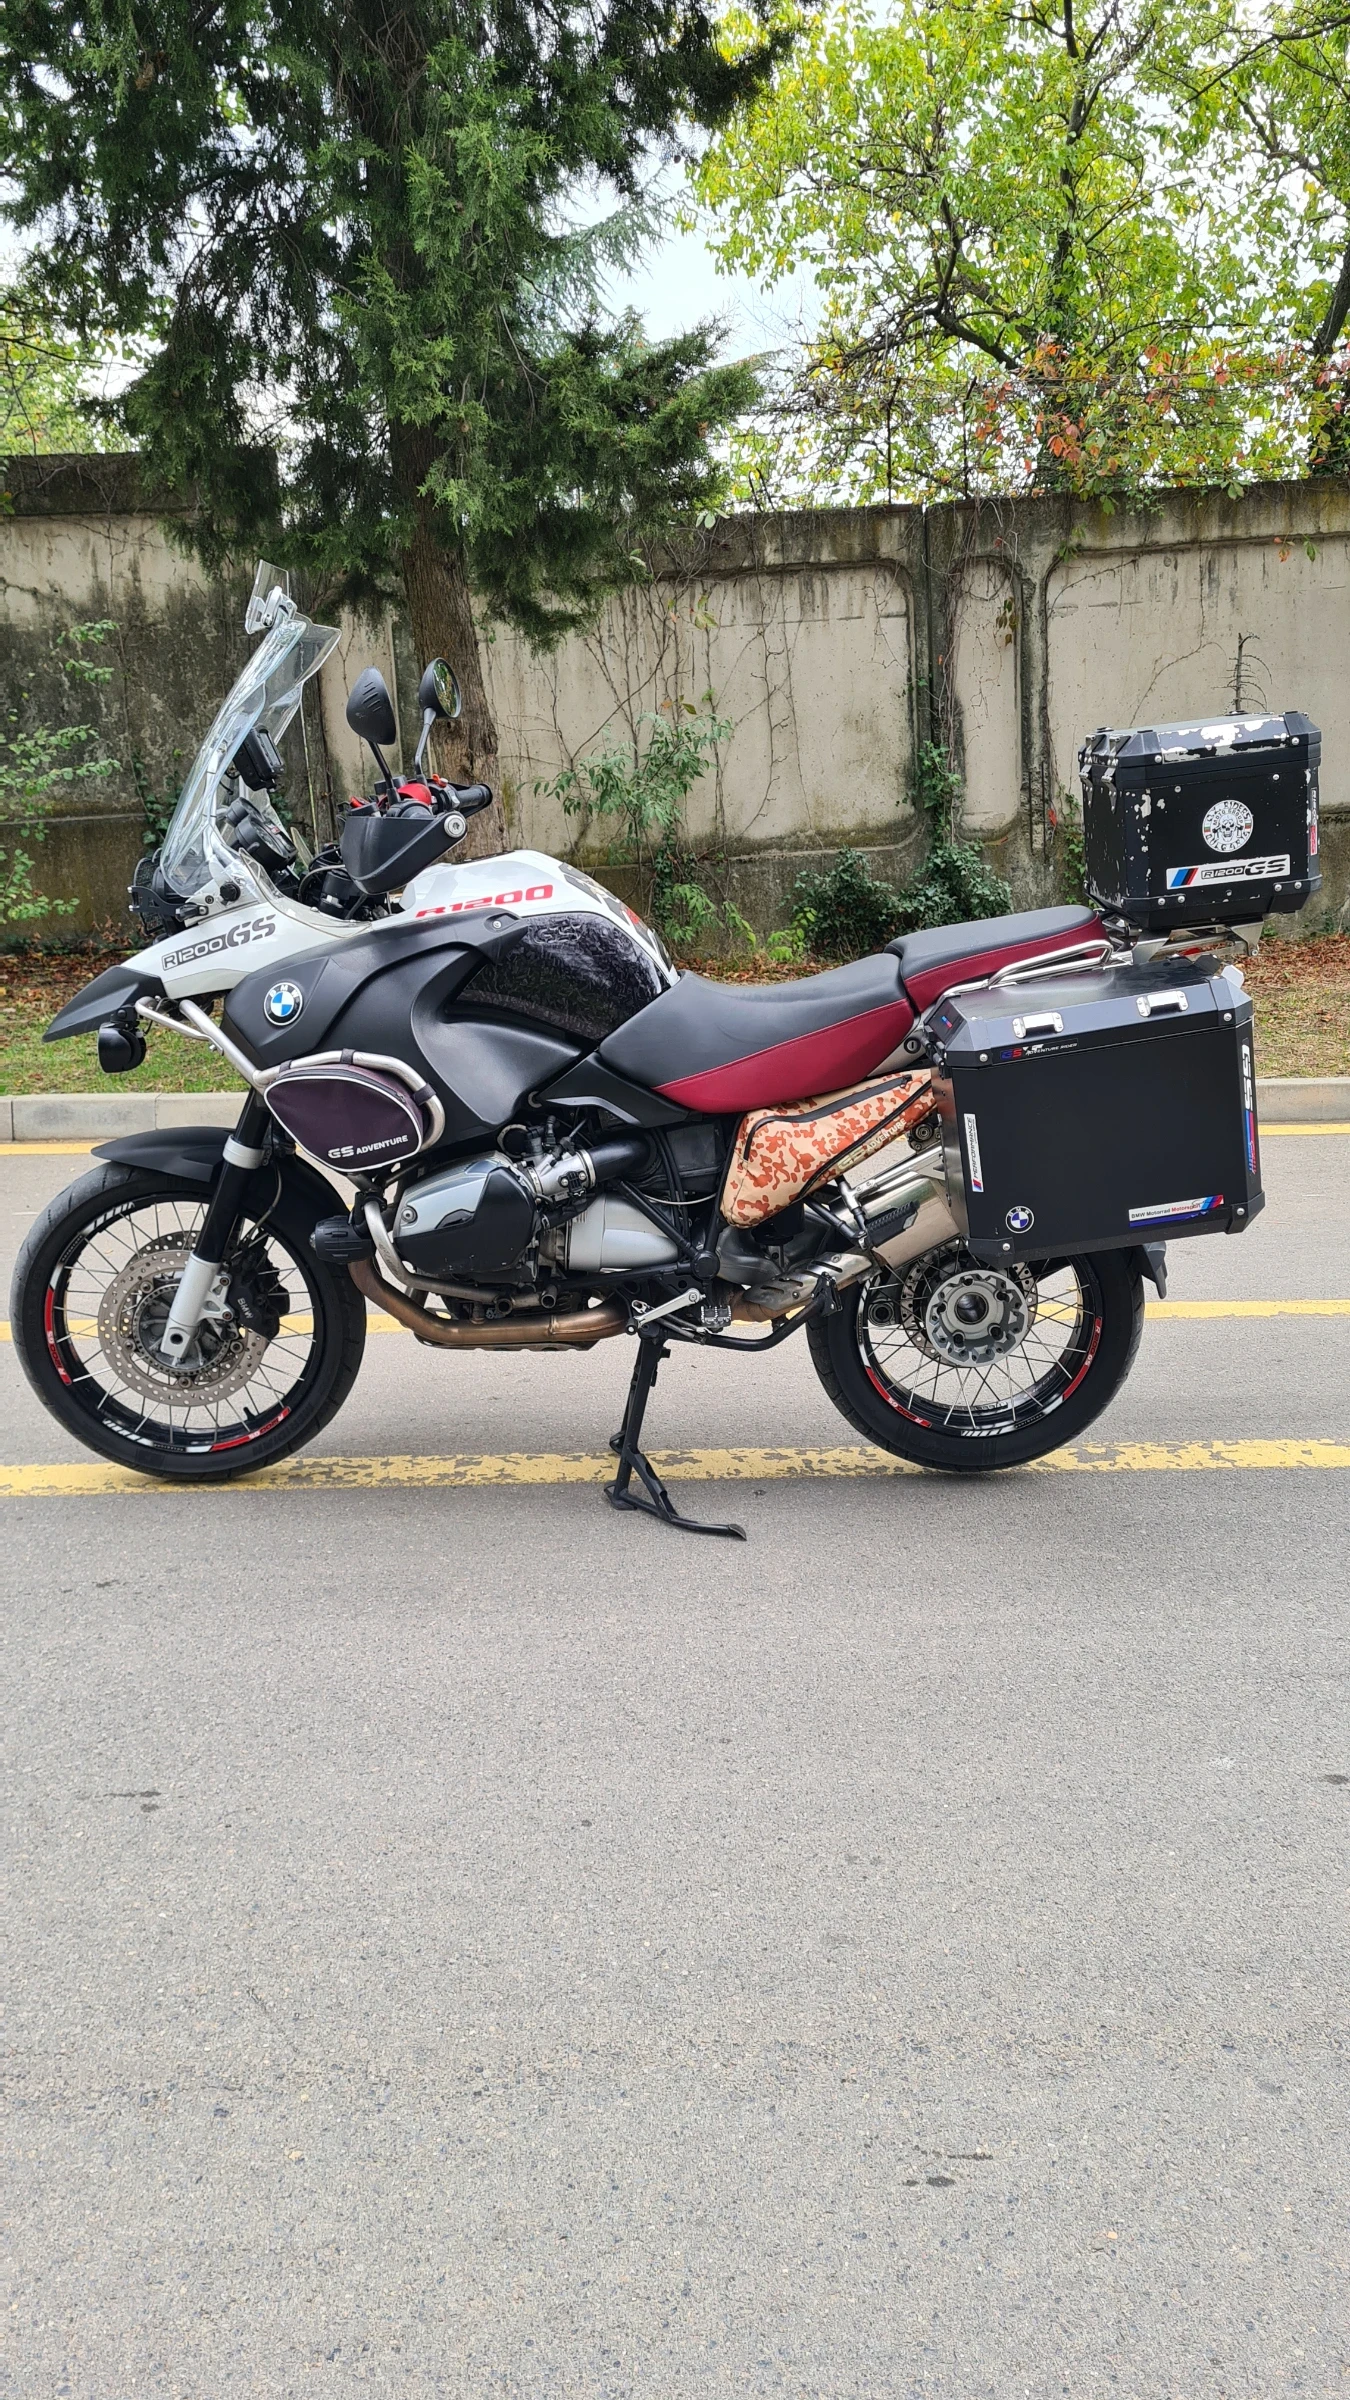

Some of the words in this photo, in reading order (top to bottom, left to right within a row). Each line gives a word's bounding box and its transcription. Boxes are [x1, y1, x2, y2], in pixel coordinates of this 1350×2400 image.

[1212, 809, 1226, 825] MOTO
[1228, 809, 1244, 824] GROUP
[415, 884, 553, 918] R1200
[268, 983, 301, 999] BMW
[1001, 1047, 1023, 1060] GS
[327, 1145, 355, 1159] GS
[356, 1134, 409, 1155] ADVENTURE
[837, 1147, 867, 1170] GS
[867, 1119, 907, 1151] ADVENTURE
[966, 1116, 979, 1179] PERFORMANCE
[1146, 1208, 1171, 1217] Motorrad
[237, 1297, 254, 1319] BMW
